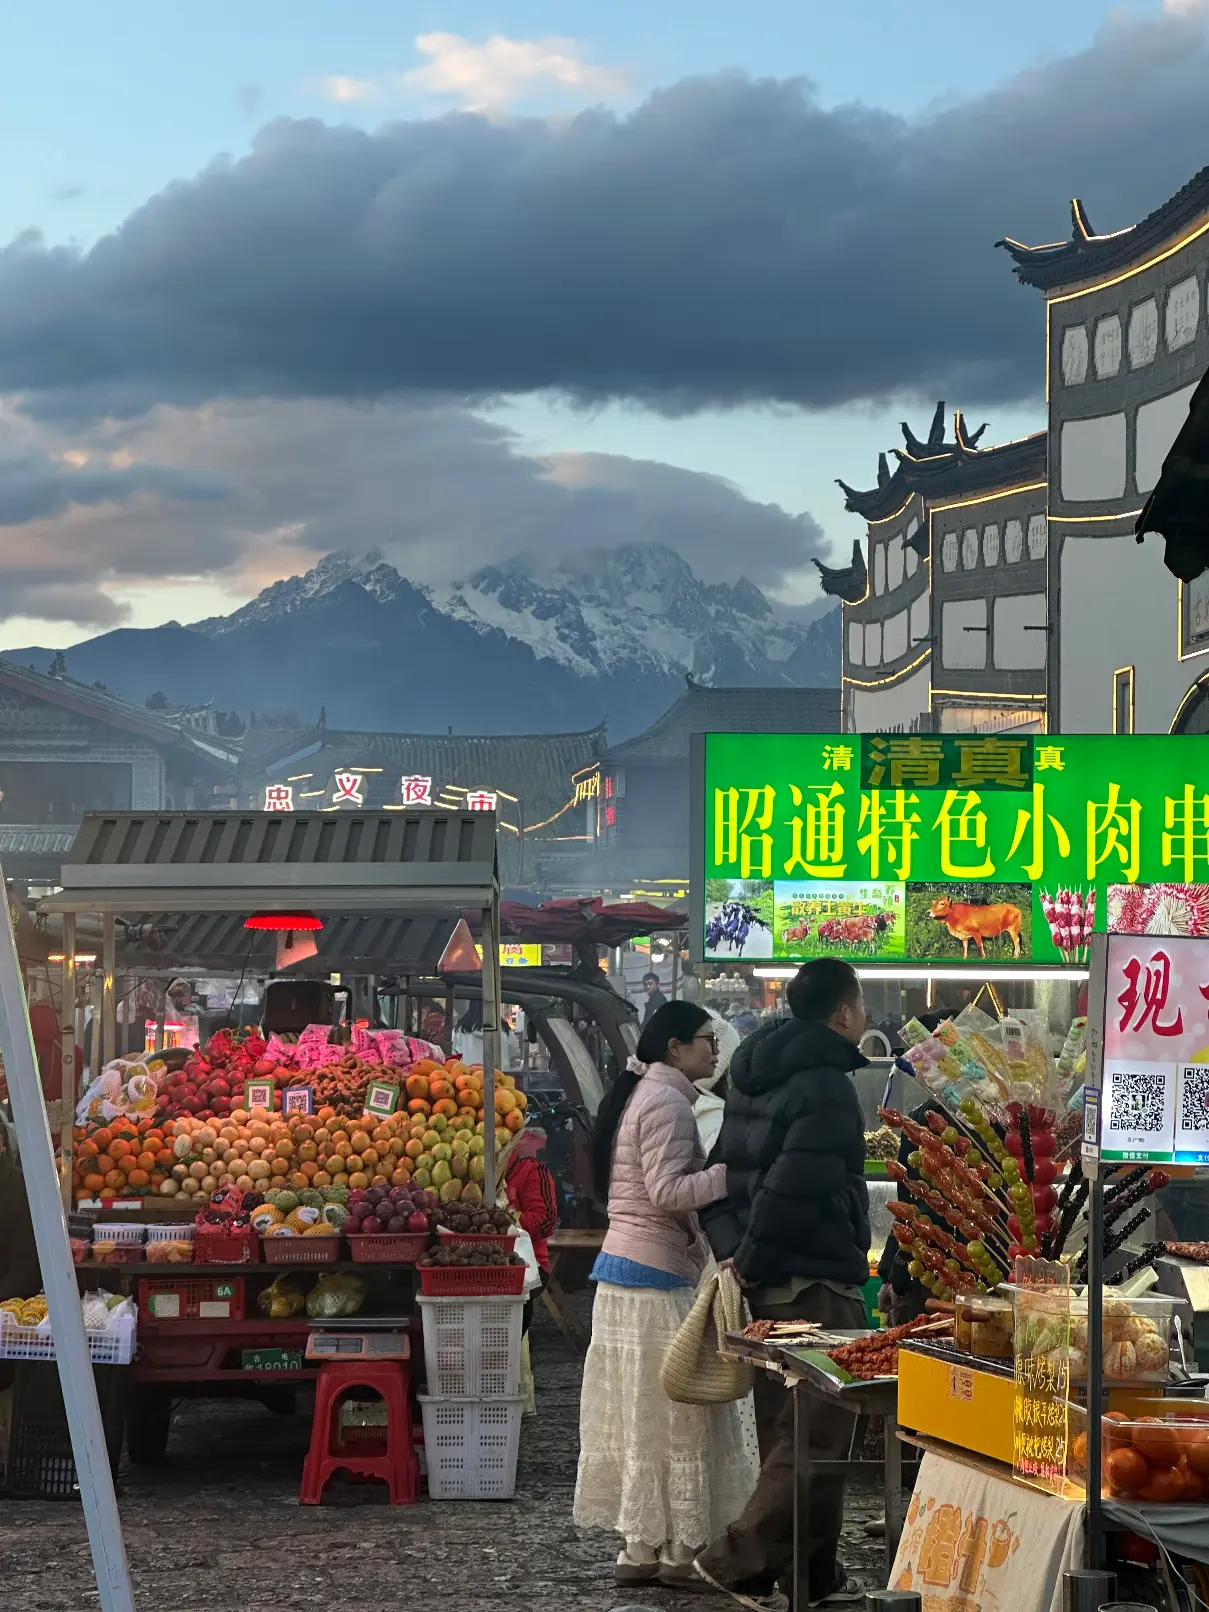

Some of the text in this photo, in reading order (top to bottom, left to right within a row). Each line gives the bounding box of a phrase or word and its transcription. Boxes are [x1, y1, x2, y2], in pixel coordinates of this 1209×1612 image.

[822, 744, 1066, 772] 清 真
[867, 736, 1029, 788] 清真
[264, 772, 498, 812] 忠义夜市
[713, 781, 1209, 883] 昭通特色小肉串
[1117, 950, 1209, 1036] 现
[217, 1286, 231, 1296] 6A
